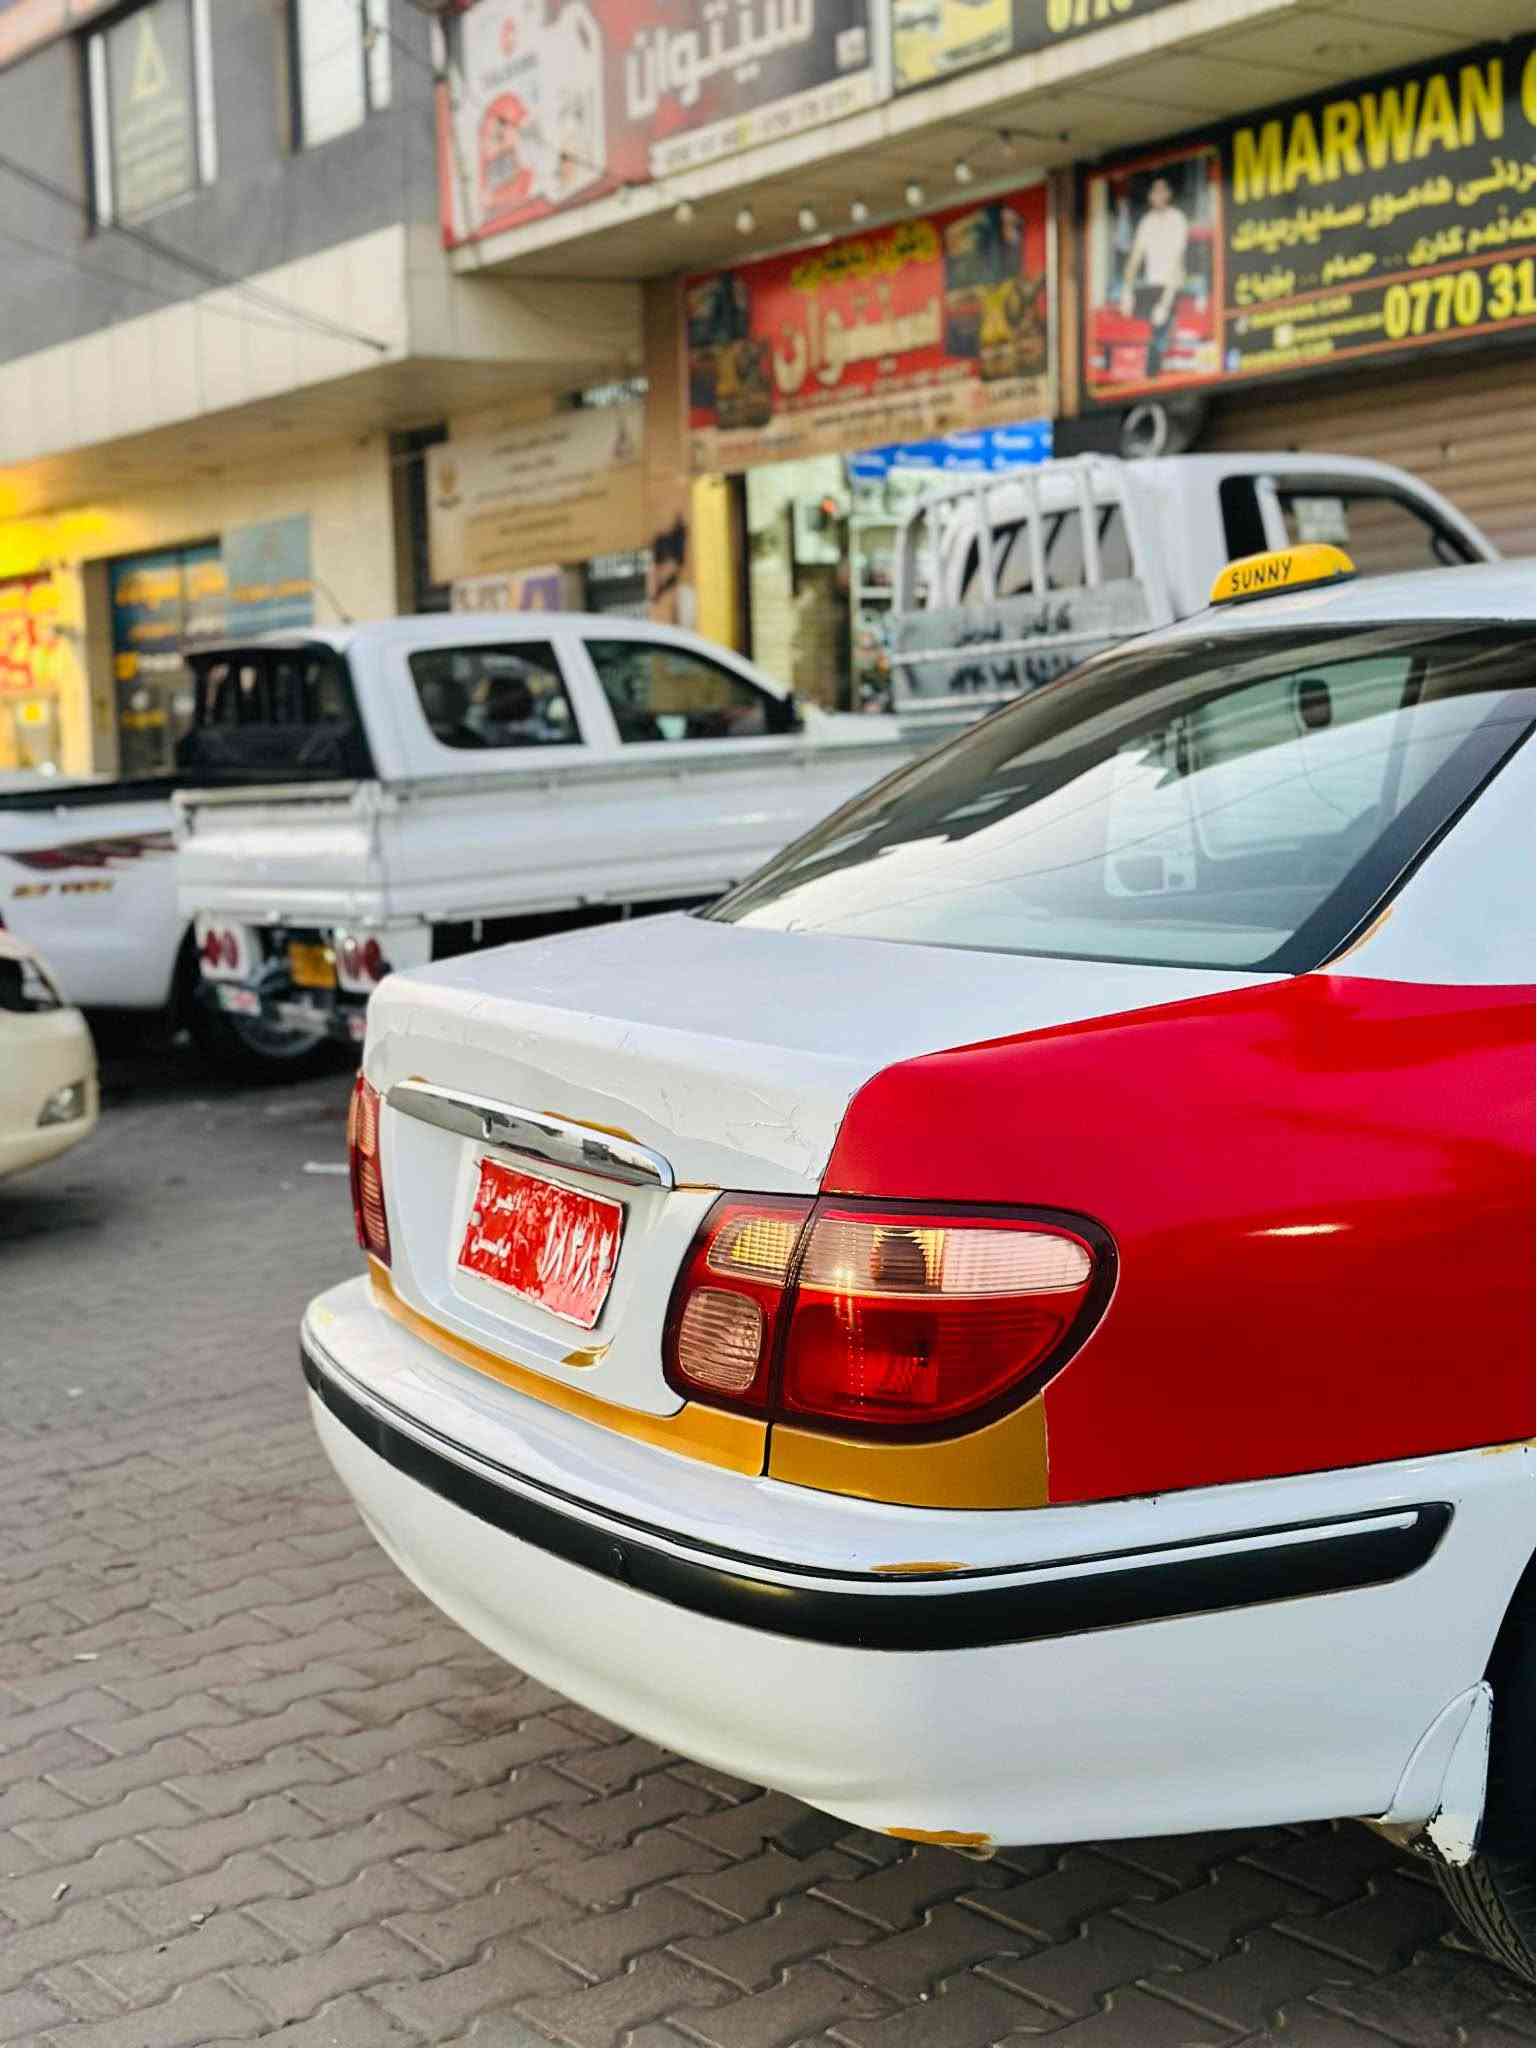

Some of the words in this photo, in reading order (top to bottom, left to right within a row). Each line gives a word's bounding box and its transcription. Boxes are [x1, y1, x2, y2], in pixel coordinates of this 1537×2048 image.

[1233, 60, 1503, 202] MARWAN
[1383, 270, 1484, 339] 0770
[1231, 556, 1293, 592] SUNNY
